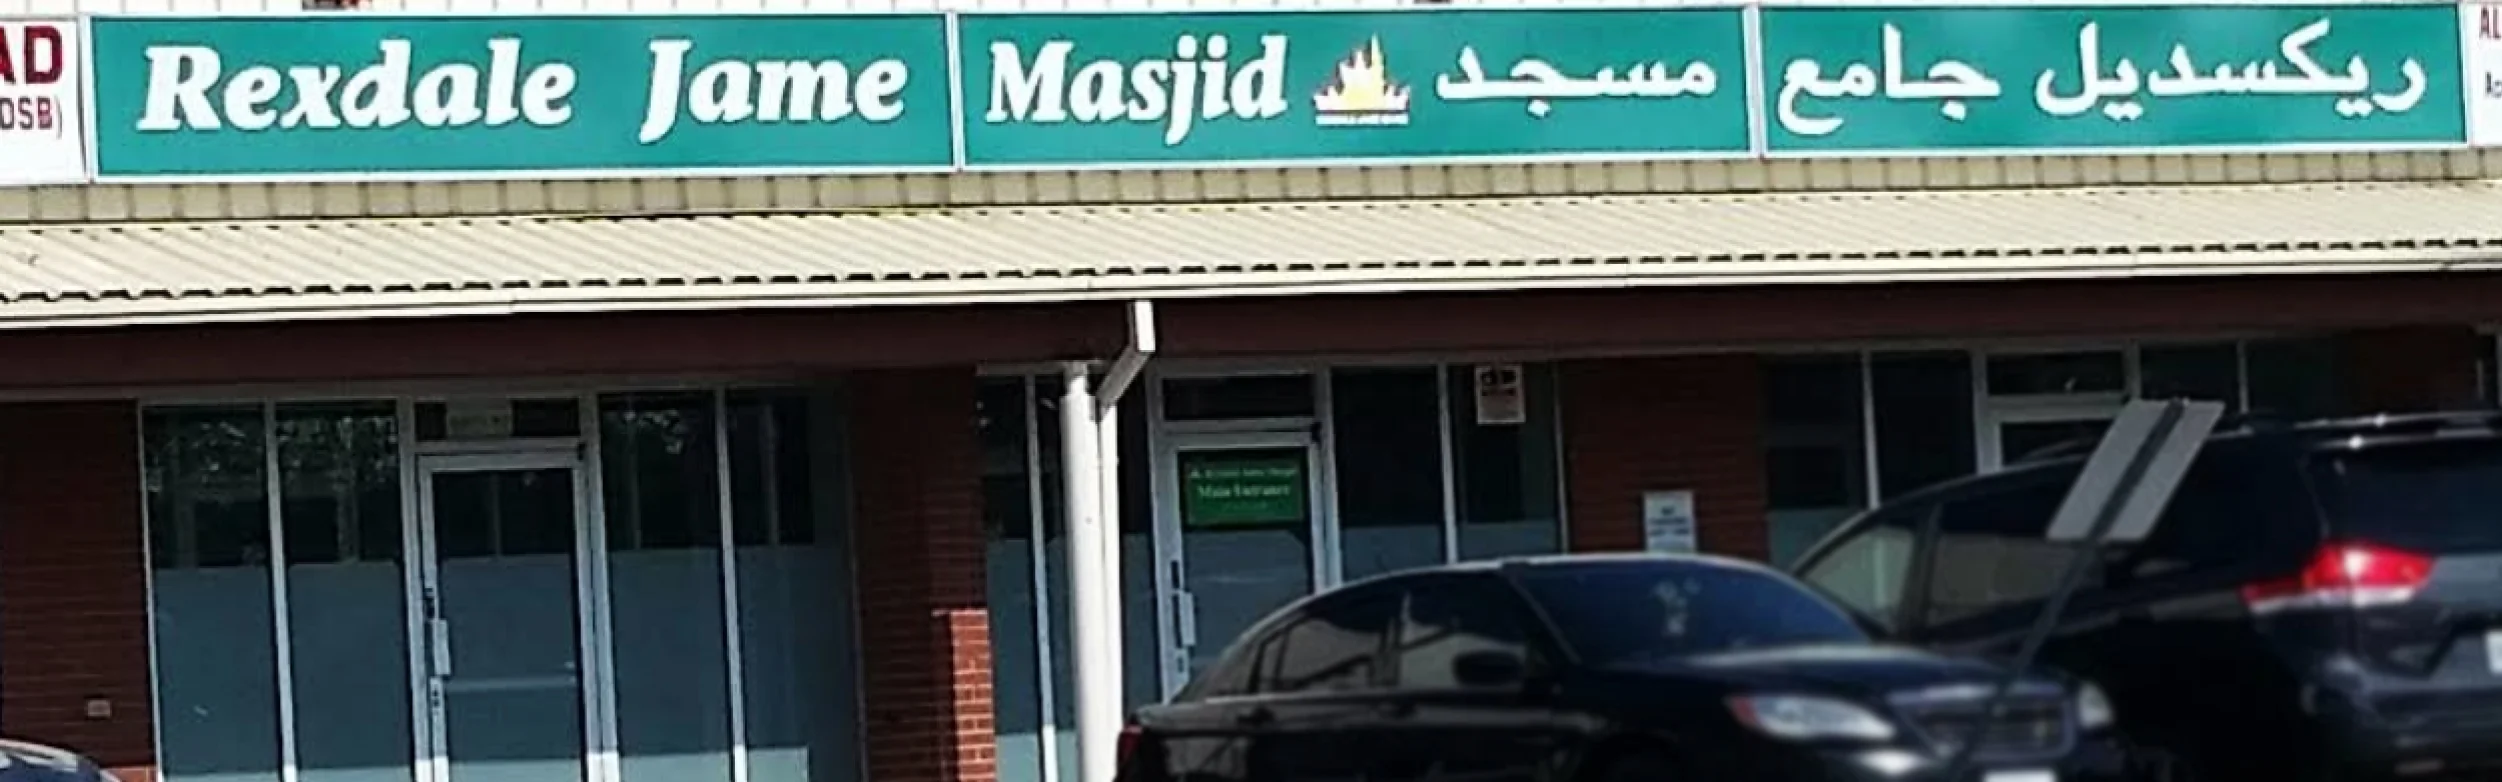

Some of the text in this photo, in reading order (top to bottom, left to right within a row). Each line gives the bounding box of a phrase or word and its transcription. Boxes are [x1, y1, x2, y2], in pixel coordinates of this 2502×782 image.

[136, 34, 1289, 146] Rexdale Jame Masjid
[1436, 18, 2428, 136] ريكسديل جامع مسجد
